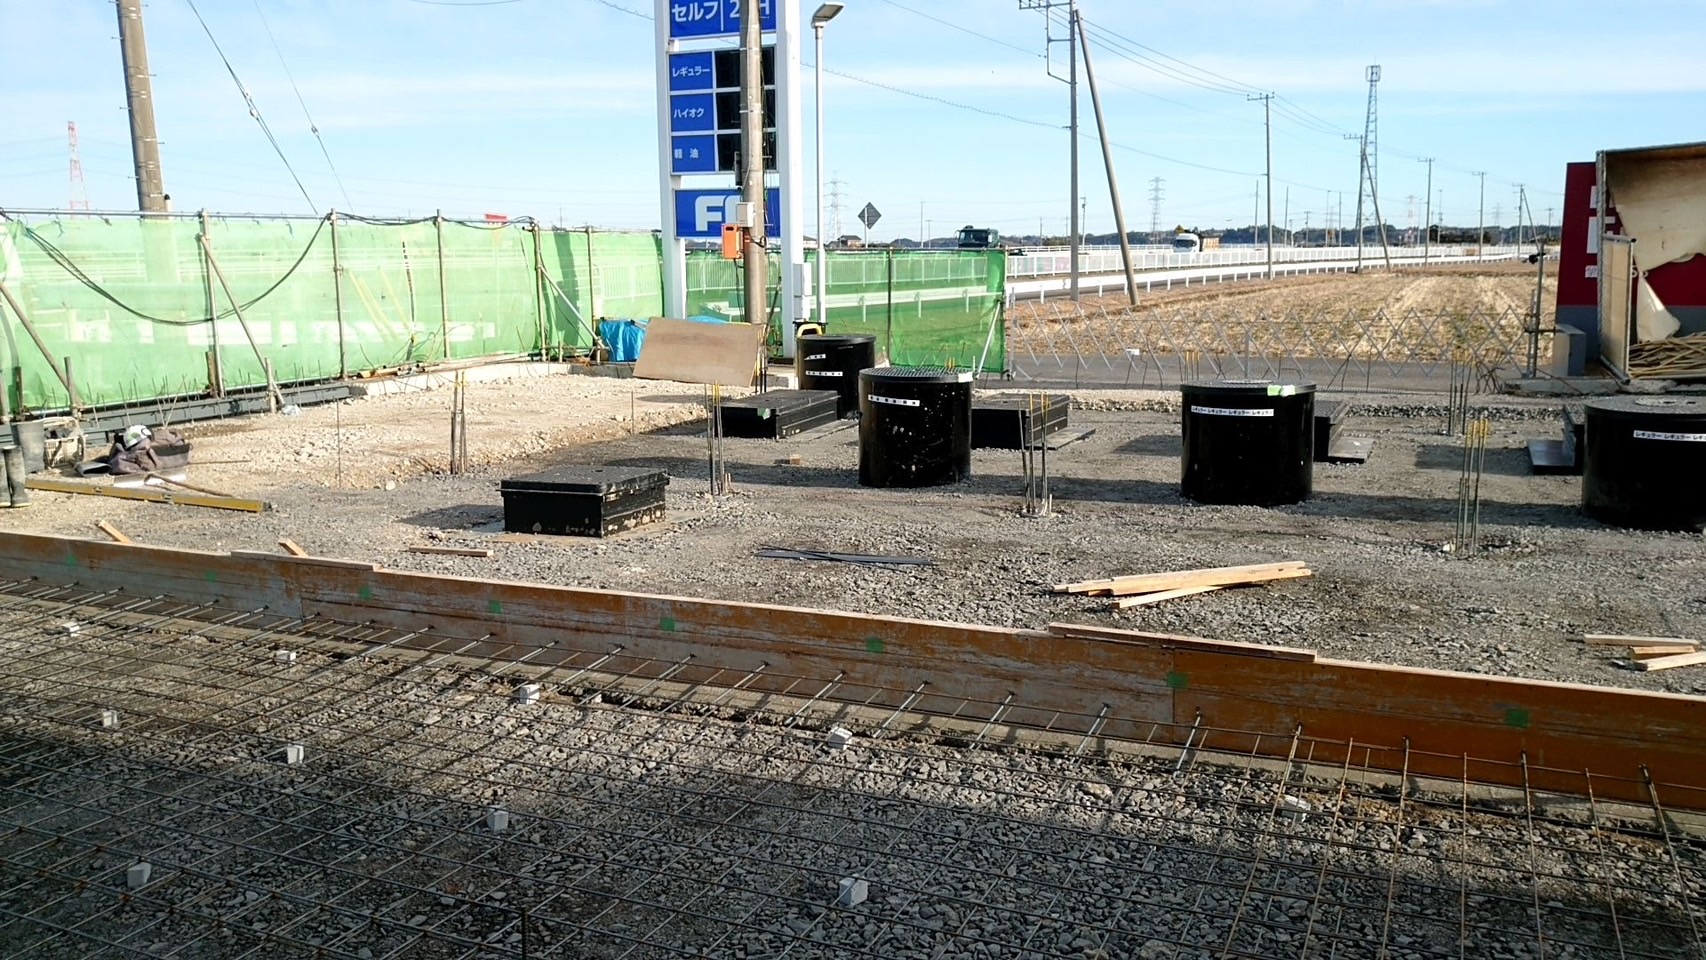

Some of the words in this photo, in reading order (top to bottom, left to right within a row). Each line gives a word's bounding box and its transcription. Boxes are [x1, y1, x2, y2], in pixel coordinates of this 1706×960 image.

[671, 1, 718, 22] セルフ
[672, 66, 710, 77] レギュラー
[673, 108, 704, 118] ハイオク
